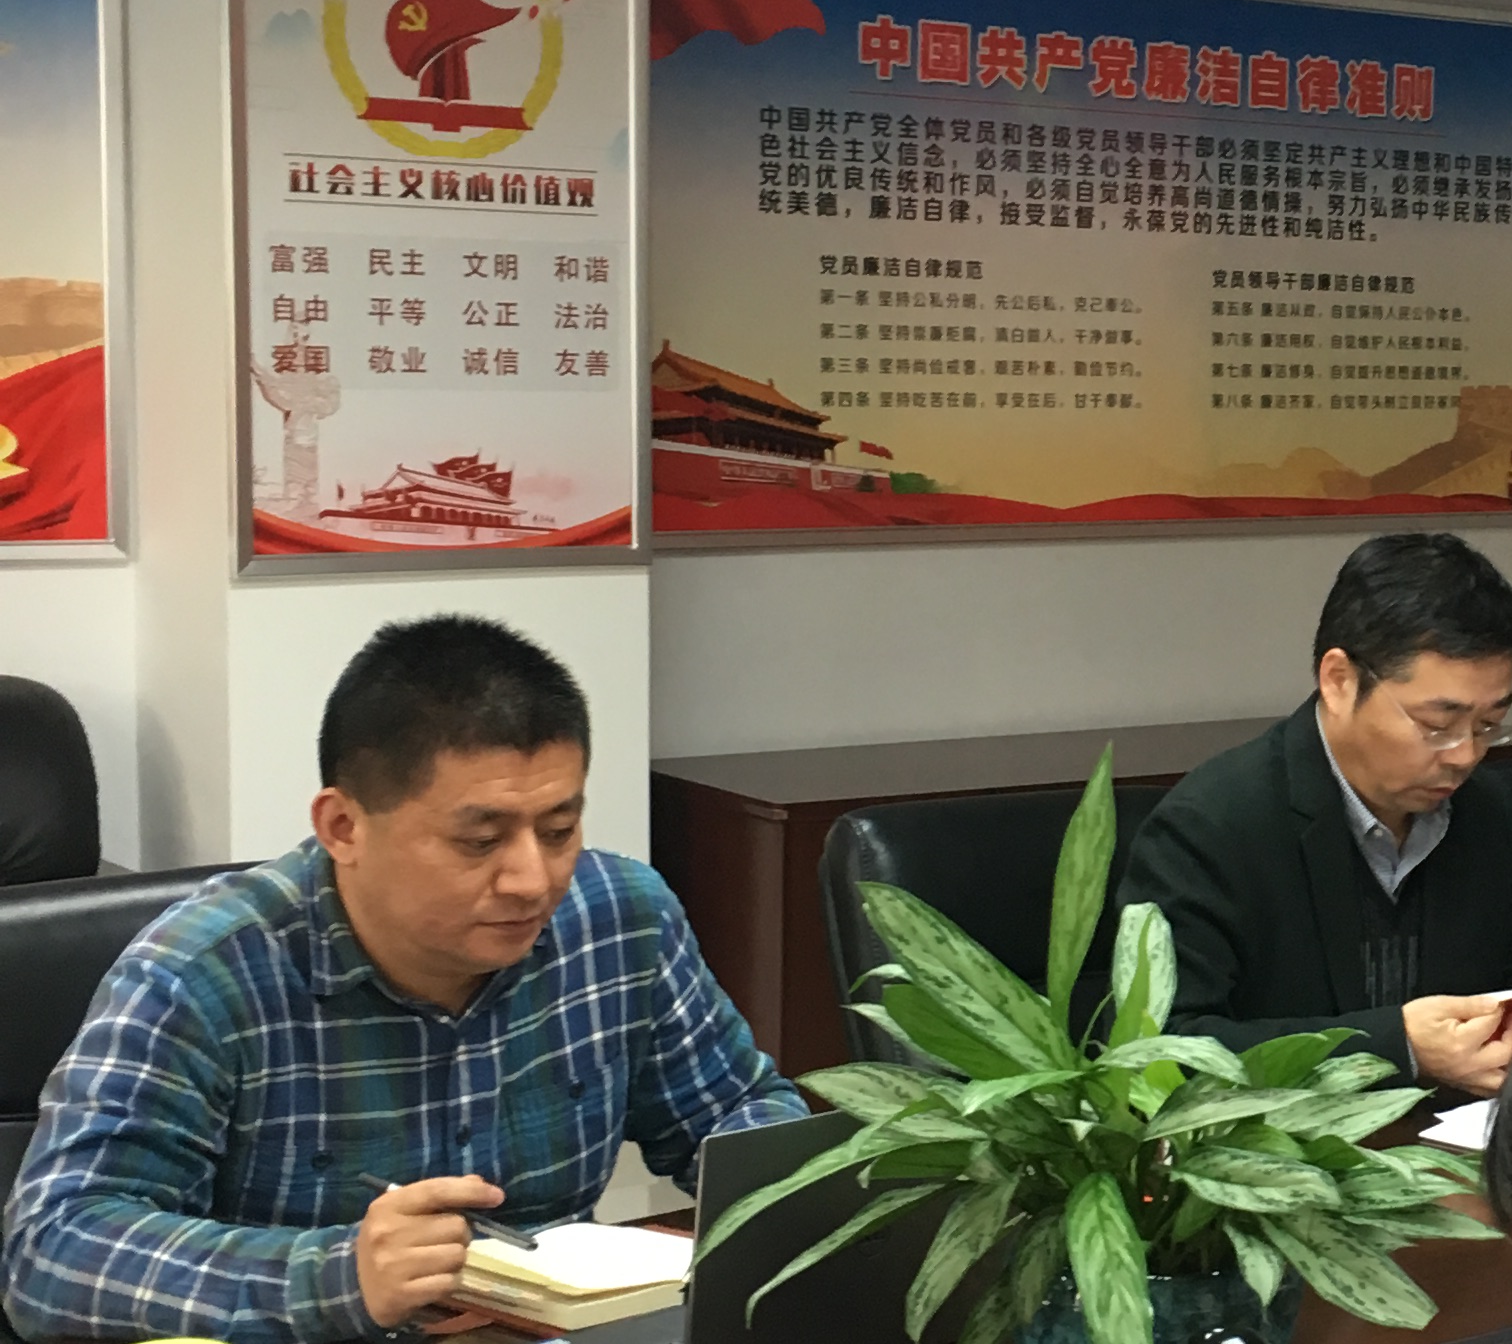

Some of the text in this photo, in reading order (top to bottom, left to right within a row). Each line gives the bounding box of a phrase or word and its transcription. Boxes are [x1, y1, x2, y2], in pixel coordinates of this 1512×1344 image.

[858, 15, 1435, 122] 中国共产党廉洁自律准则
[288, 162, 595, 208] 社会主义核心价值观
[759, 133, 1512, 202] 色社会主义信念，必须坚持全心全意为人民服务根本宗旨，必须继承发扬
[758, 161, 1512, 226] 党的优良传统和作风，必须自觉培养高尚道德情操，努力弘扬中华民族传
[268, 243, 610, 284] 富强 民主 文明 和谐
[819, 254, 984, 281] 党员廉洁自律规范
[1211, 269, 1416, 295] 党员领导干部廉洁自律规范
[271, 294, 609, 331] 自由 平等 公正 法治
[270, 344, 611, 377] 爱国 敬业 诚信 友善
